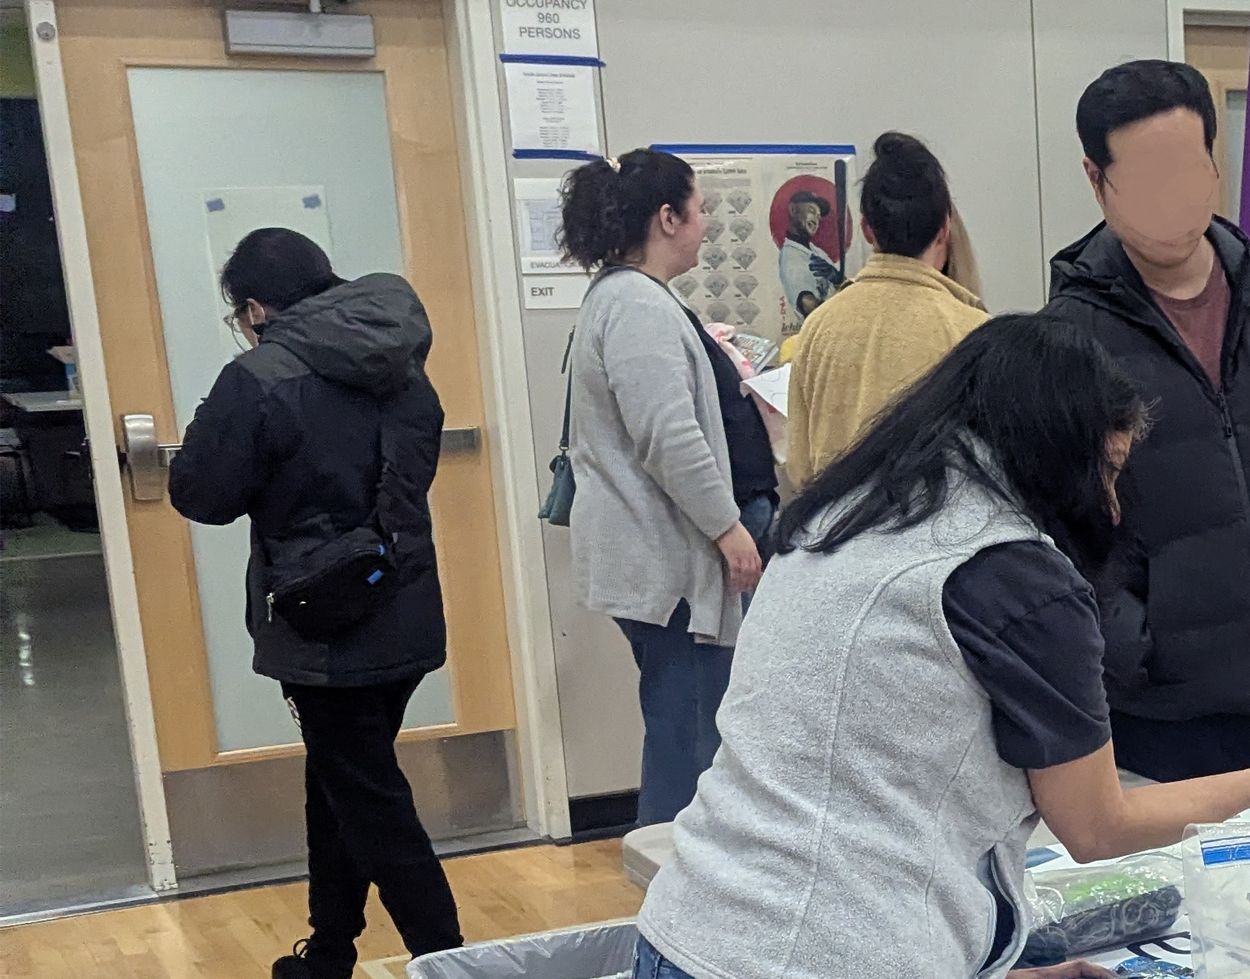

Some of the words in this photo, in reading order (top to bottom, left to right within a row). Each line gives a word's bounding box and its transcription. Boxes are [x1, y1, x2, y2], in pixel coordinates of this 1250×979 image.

[506, 0, 588, 10] OCCUPANCY
[537, 13, 560, 24] 960
[519, 27, 581, 39] PERSONS
[530, 287, 554, 297] EXIT
